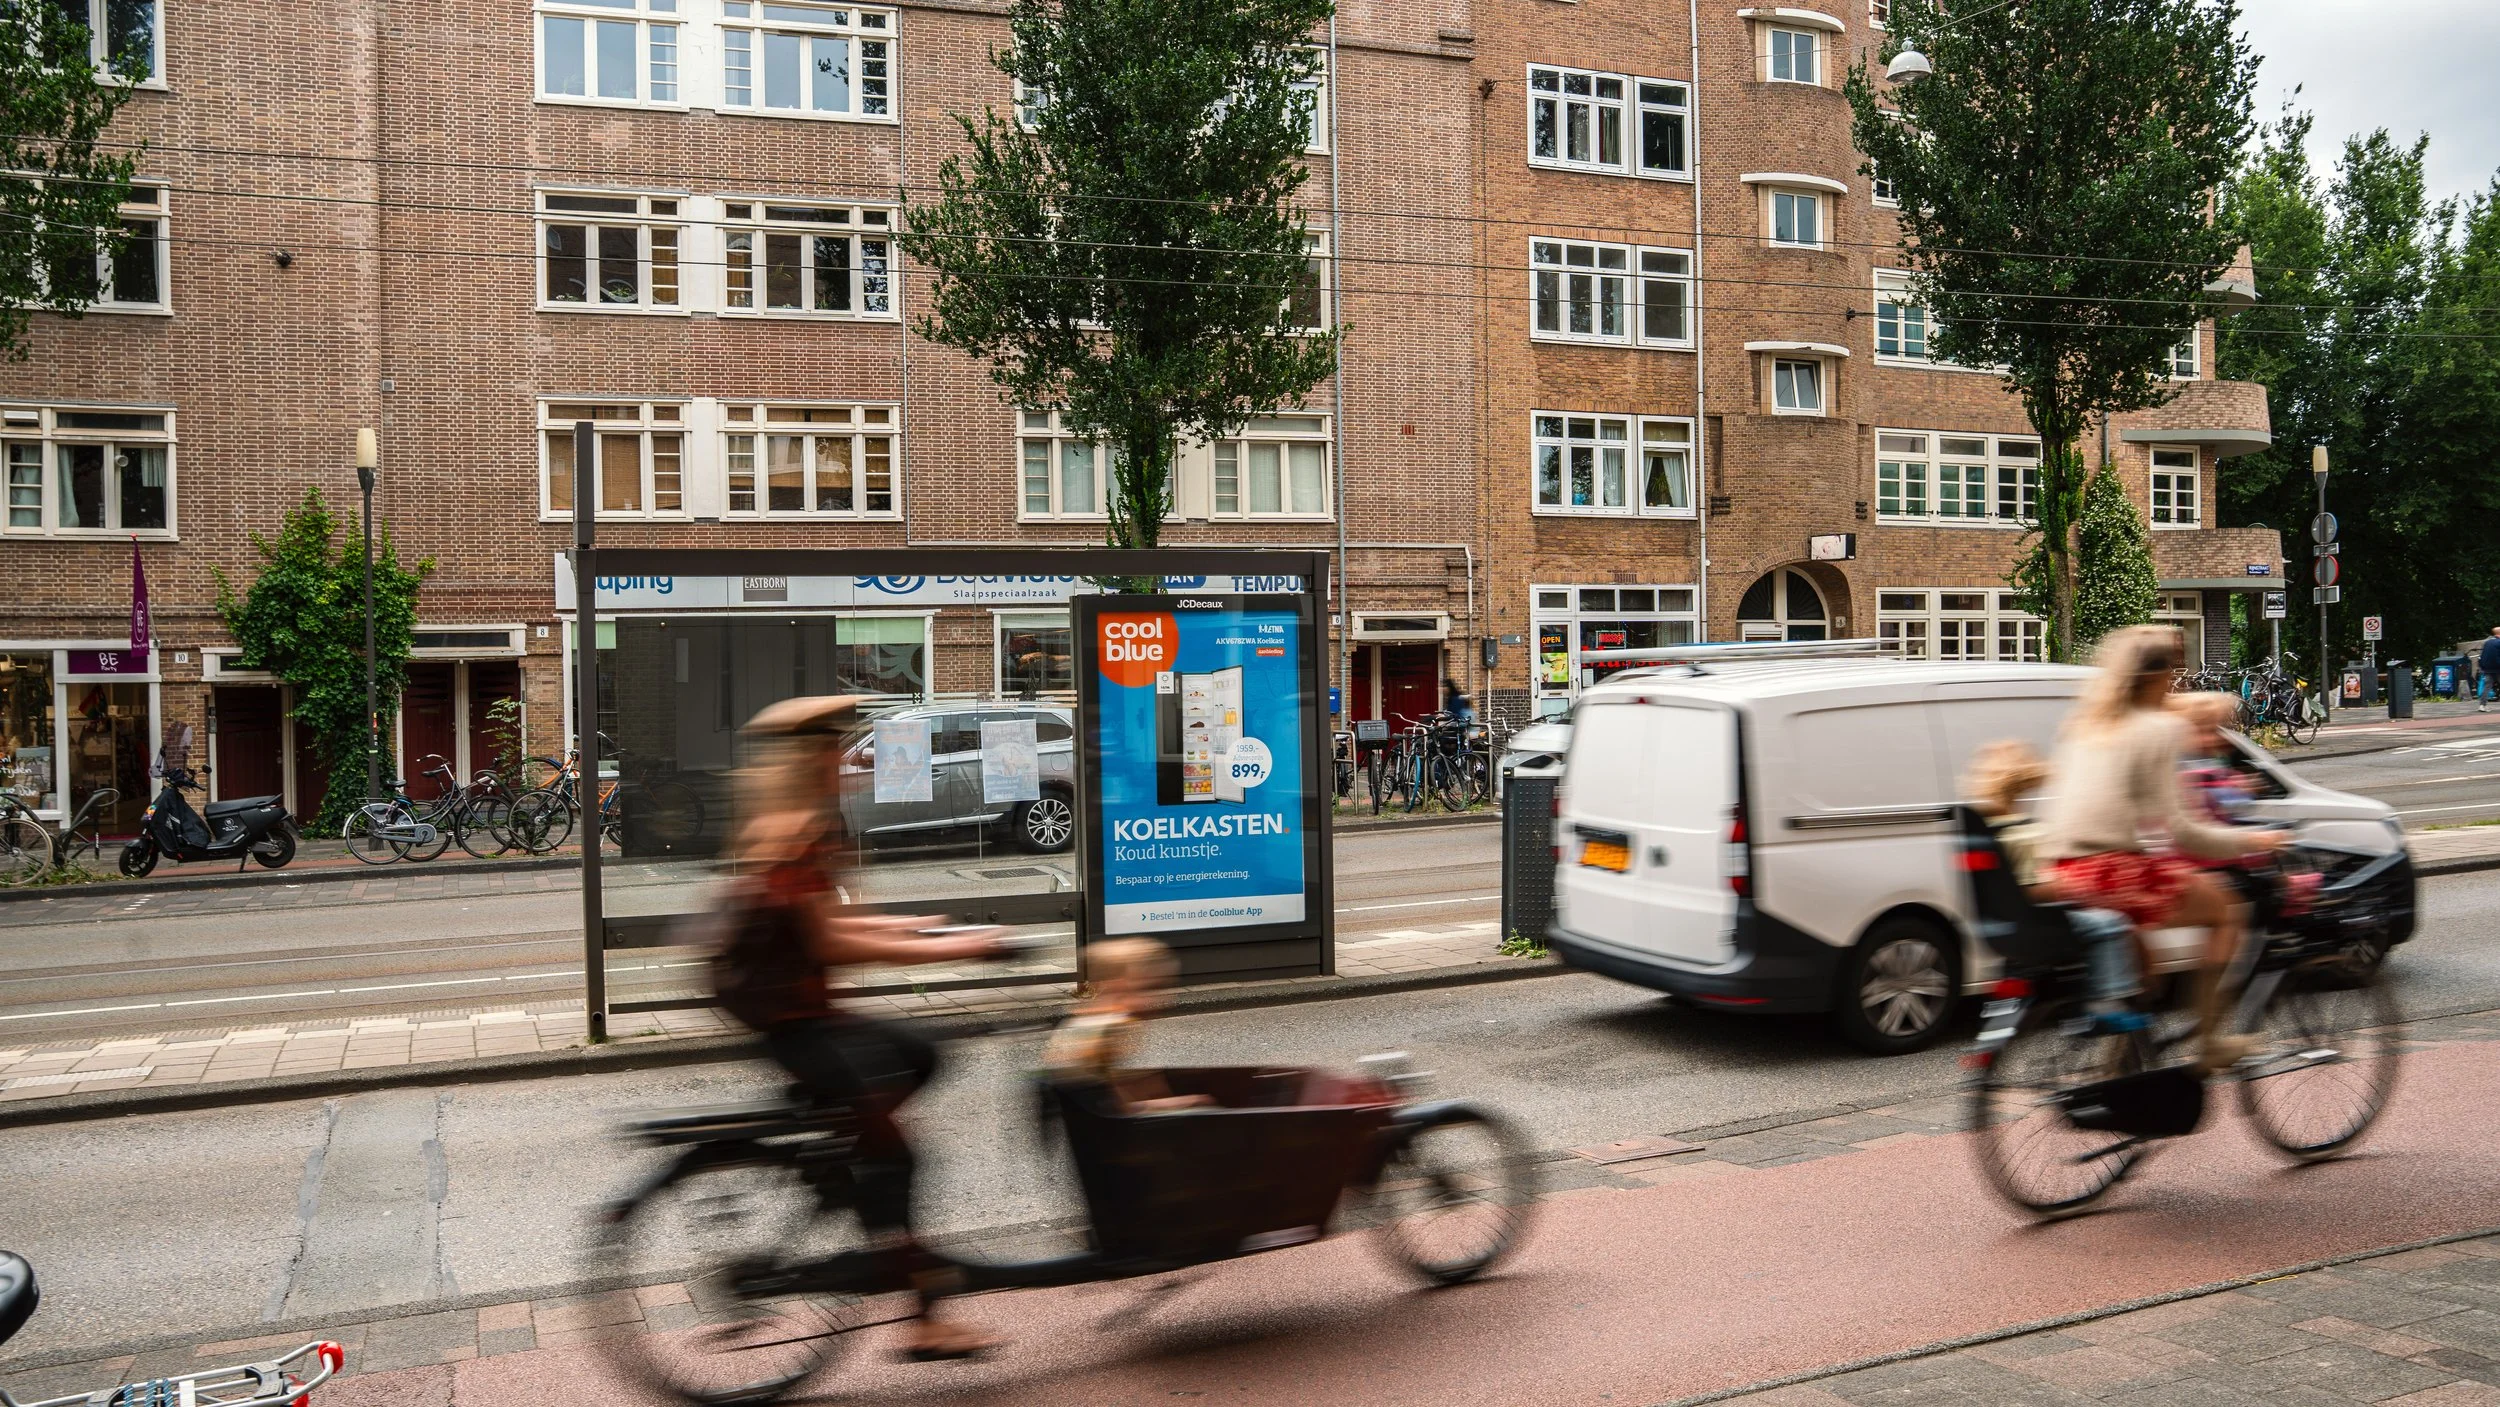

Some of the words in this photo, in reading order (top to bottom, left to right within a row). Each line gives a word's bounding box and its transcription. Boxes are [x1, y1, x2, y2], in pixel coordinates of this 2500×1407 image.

[744, 577, 786, 589] EASTBORN
[953, 588, 1057, 599] Slaapspeciaalzaak
[1177, 599, 1223, 609] JCDecaux
[1335, 616, 1340, 624] 6
[540, 628, 545, 636] 8
[1105, 618, 1163, 639] cool
[1515, 635, 1521, 643] 4
[1541, 635, 1561, 644] OPEN
[1106, 639, 1164, 662] blue
[99, 652, 119, 667] BE
[177, 654, 186, 662] 10
[1236, 744, 1260, 753] 1959,-
[1231, 763, 1266, 779] 899,-
[1114, 813, 1290, 841] KOELKASTEN.
[1115, 844, 1156, 861] Koud
[1159, 841, 1222, 860] kunstje.
[1115, 875, 1151, 886] Bespaar
[1153, 874, 1165, 884] op
[1166, 873, 1174, 884] je
[1175, 869, 1250, 883] energierekening.
[1150, 910, 1175, 921] Bestel
[1187, 910, 1196, 919] in
[1197, 909, 1208, 918] de
[1209, 907, 1245, 917] Coolblue
[1246, 906, 1263, 917] App
